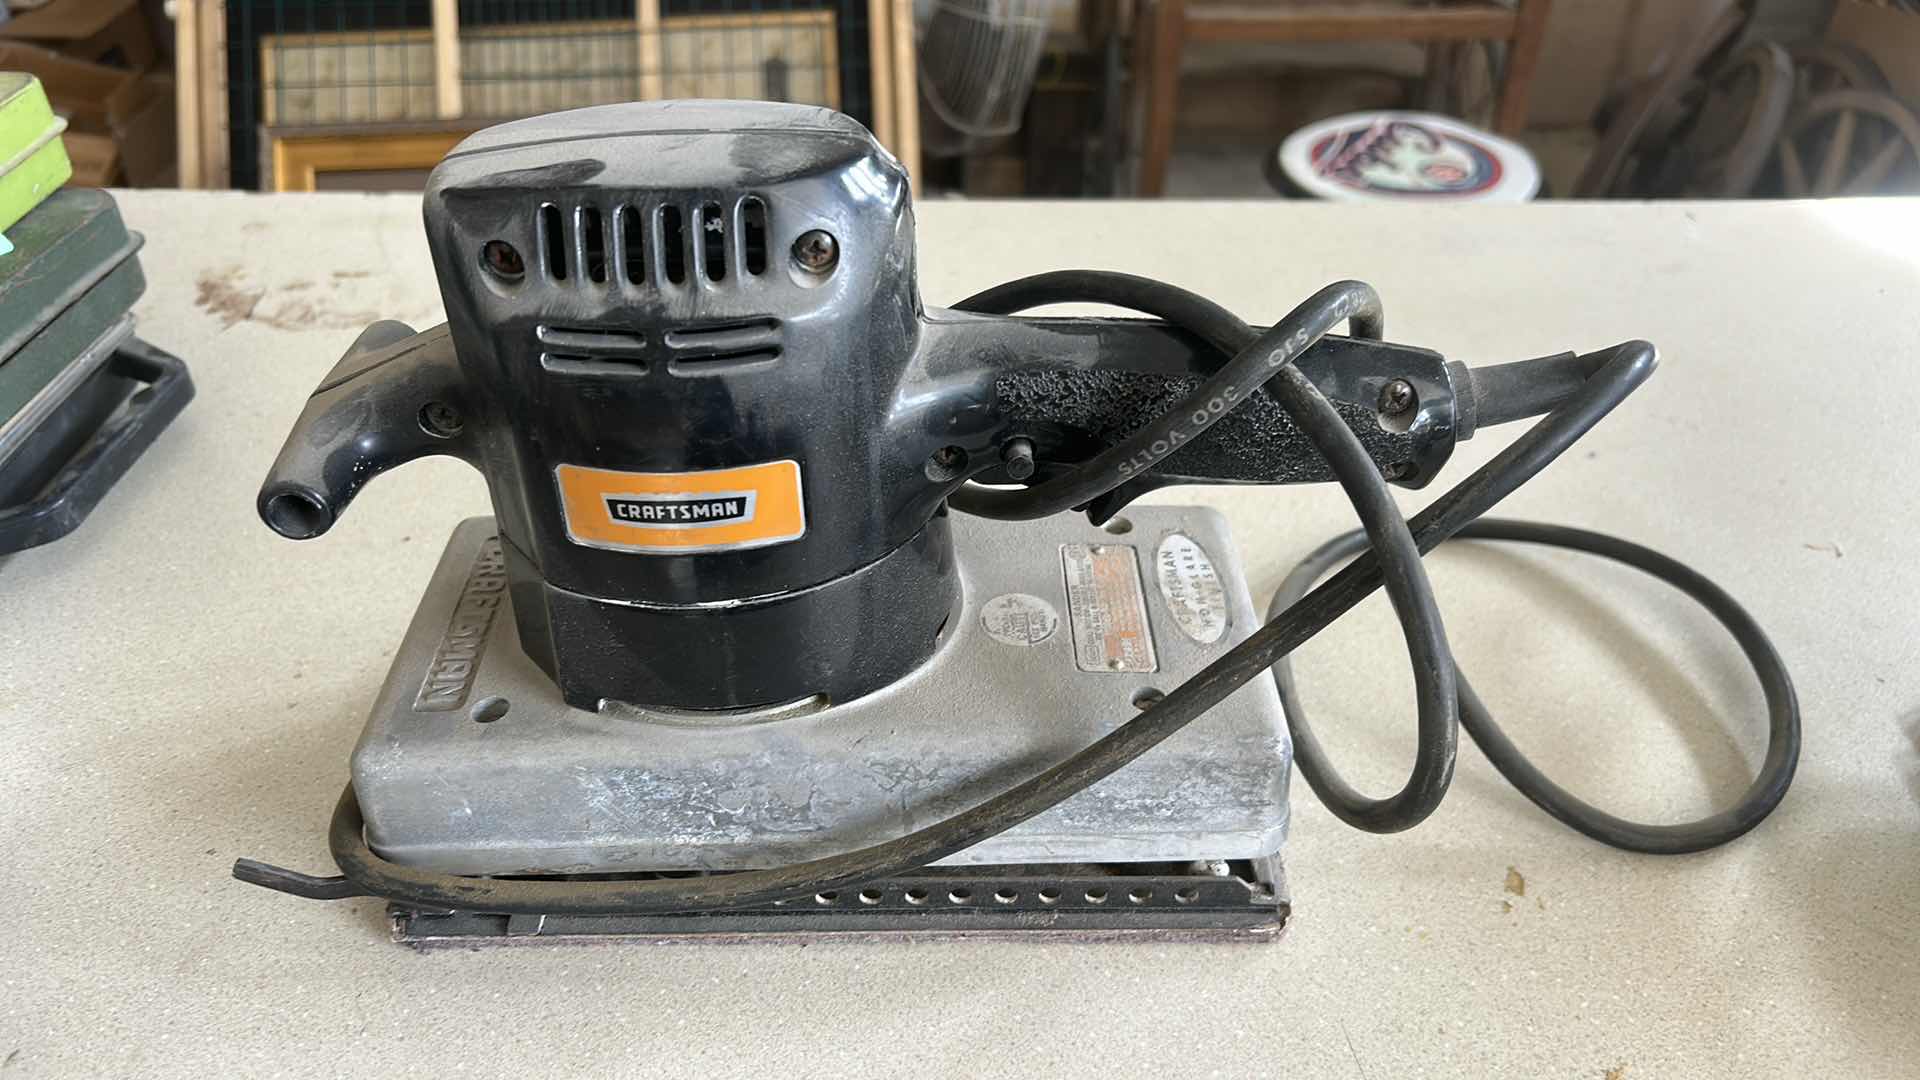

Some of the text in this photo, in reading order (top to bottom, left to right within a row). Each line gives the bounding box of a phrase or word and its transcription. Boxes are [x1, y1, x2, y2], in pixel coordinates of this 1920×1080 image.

[1118, 326, 1308, 476] SJO 300 VOLTS
[616, 500, 739, 519] CRAFTSMAN
